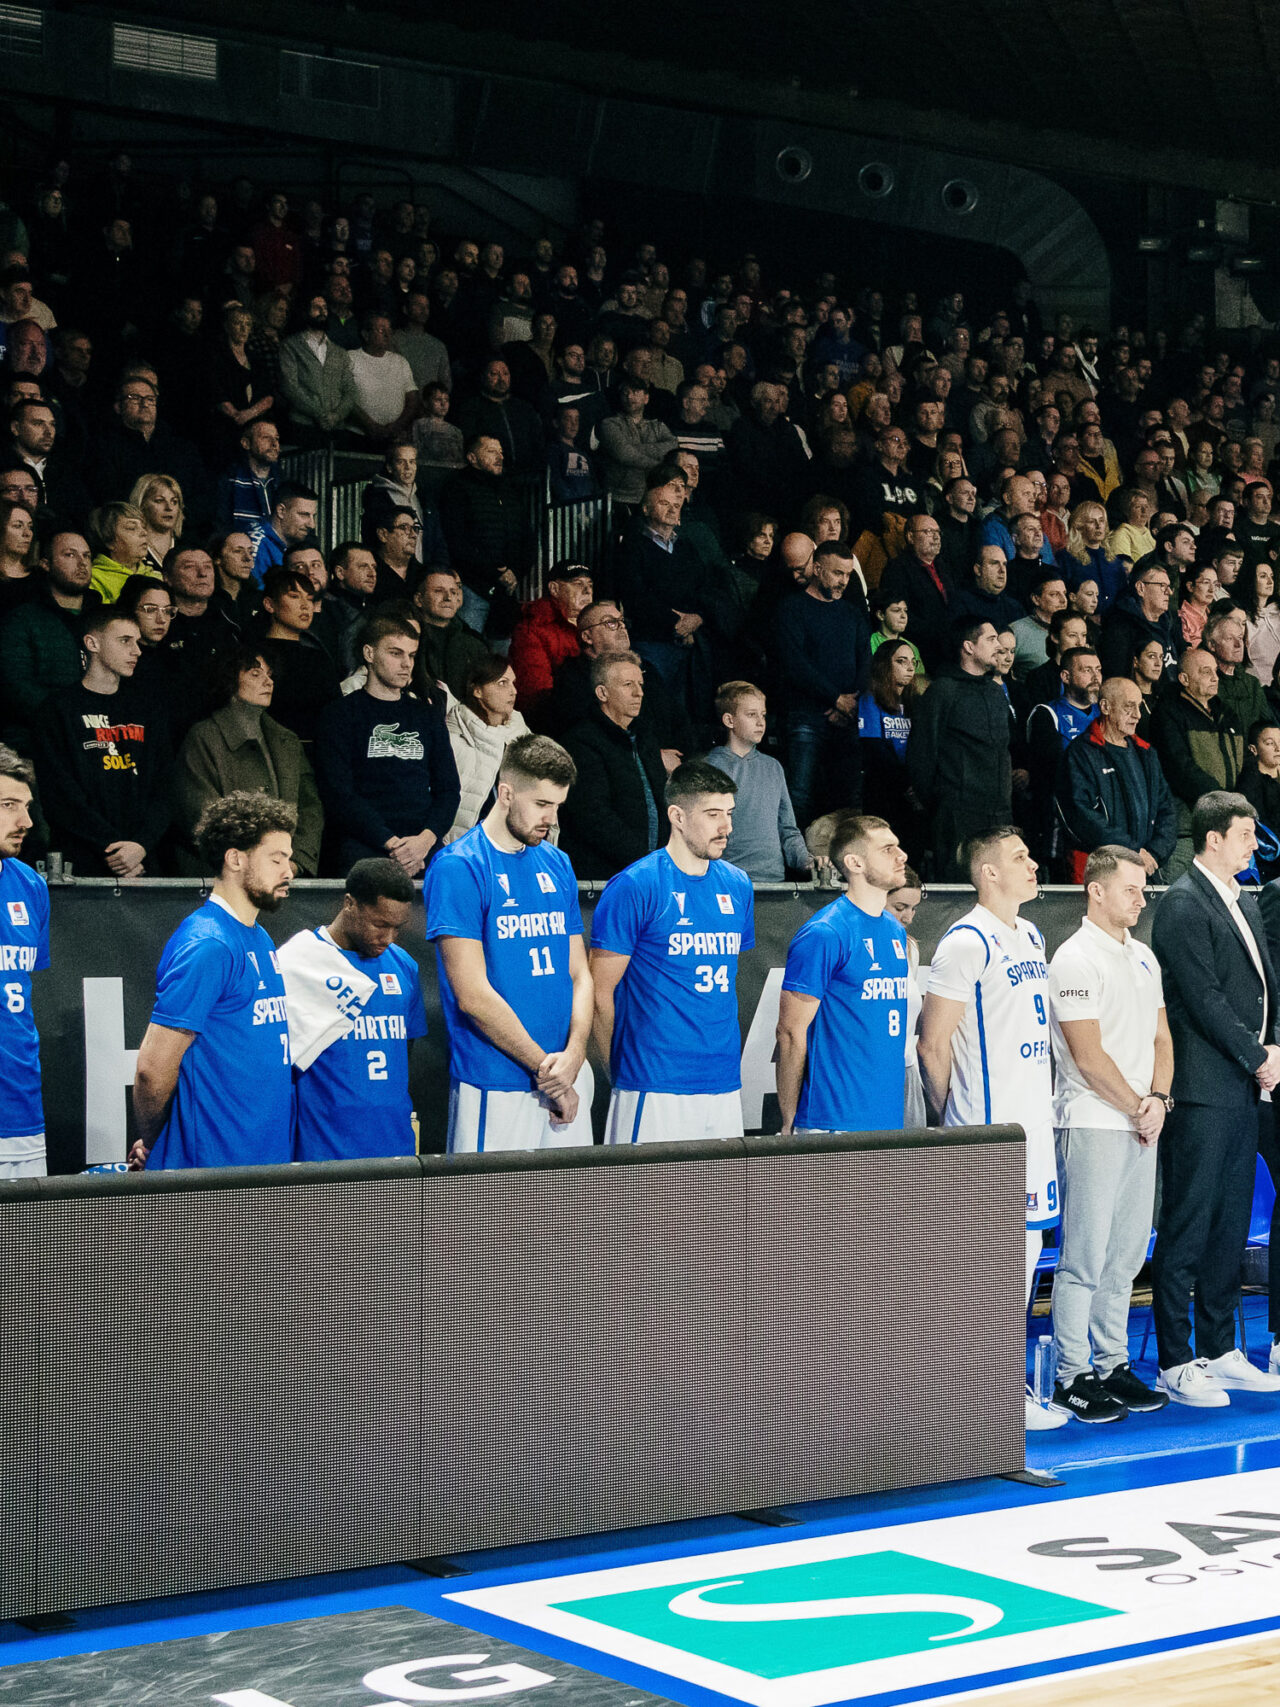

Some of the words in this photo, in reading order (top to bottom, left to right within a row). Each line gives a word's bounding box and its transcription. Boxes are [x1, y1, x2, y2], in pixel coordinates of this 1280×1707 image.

[82, 714, 111, 729] NIKE
[497, 911, 567, 939] SPARTAK
[529, 946, 556, 976] 11
[694, 964, 730, 993] 34
[4, 982, 25, 1014] 6
[1059, 989, 1089, 998] OFFICE
[888, 1009, 901, 1037] 8
[1033, 993, 1047, 1026] 9
[280, 1033, 289, 1065] 7
[366, 1050, 388, 1080] 2
[1047, 1180, 1057, 1212] 9
[1068, 1394, 1089, 1410] HOKA
